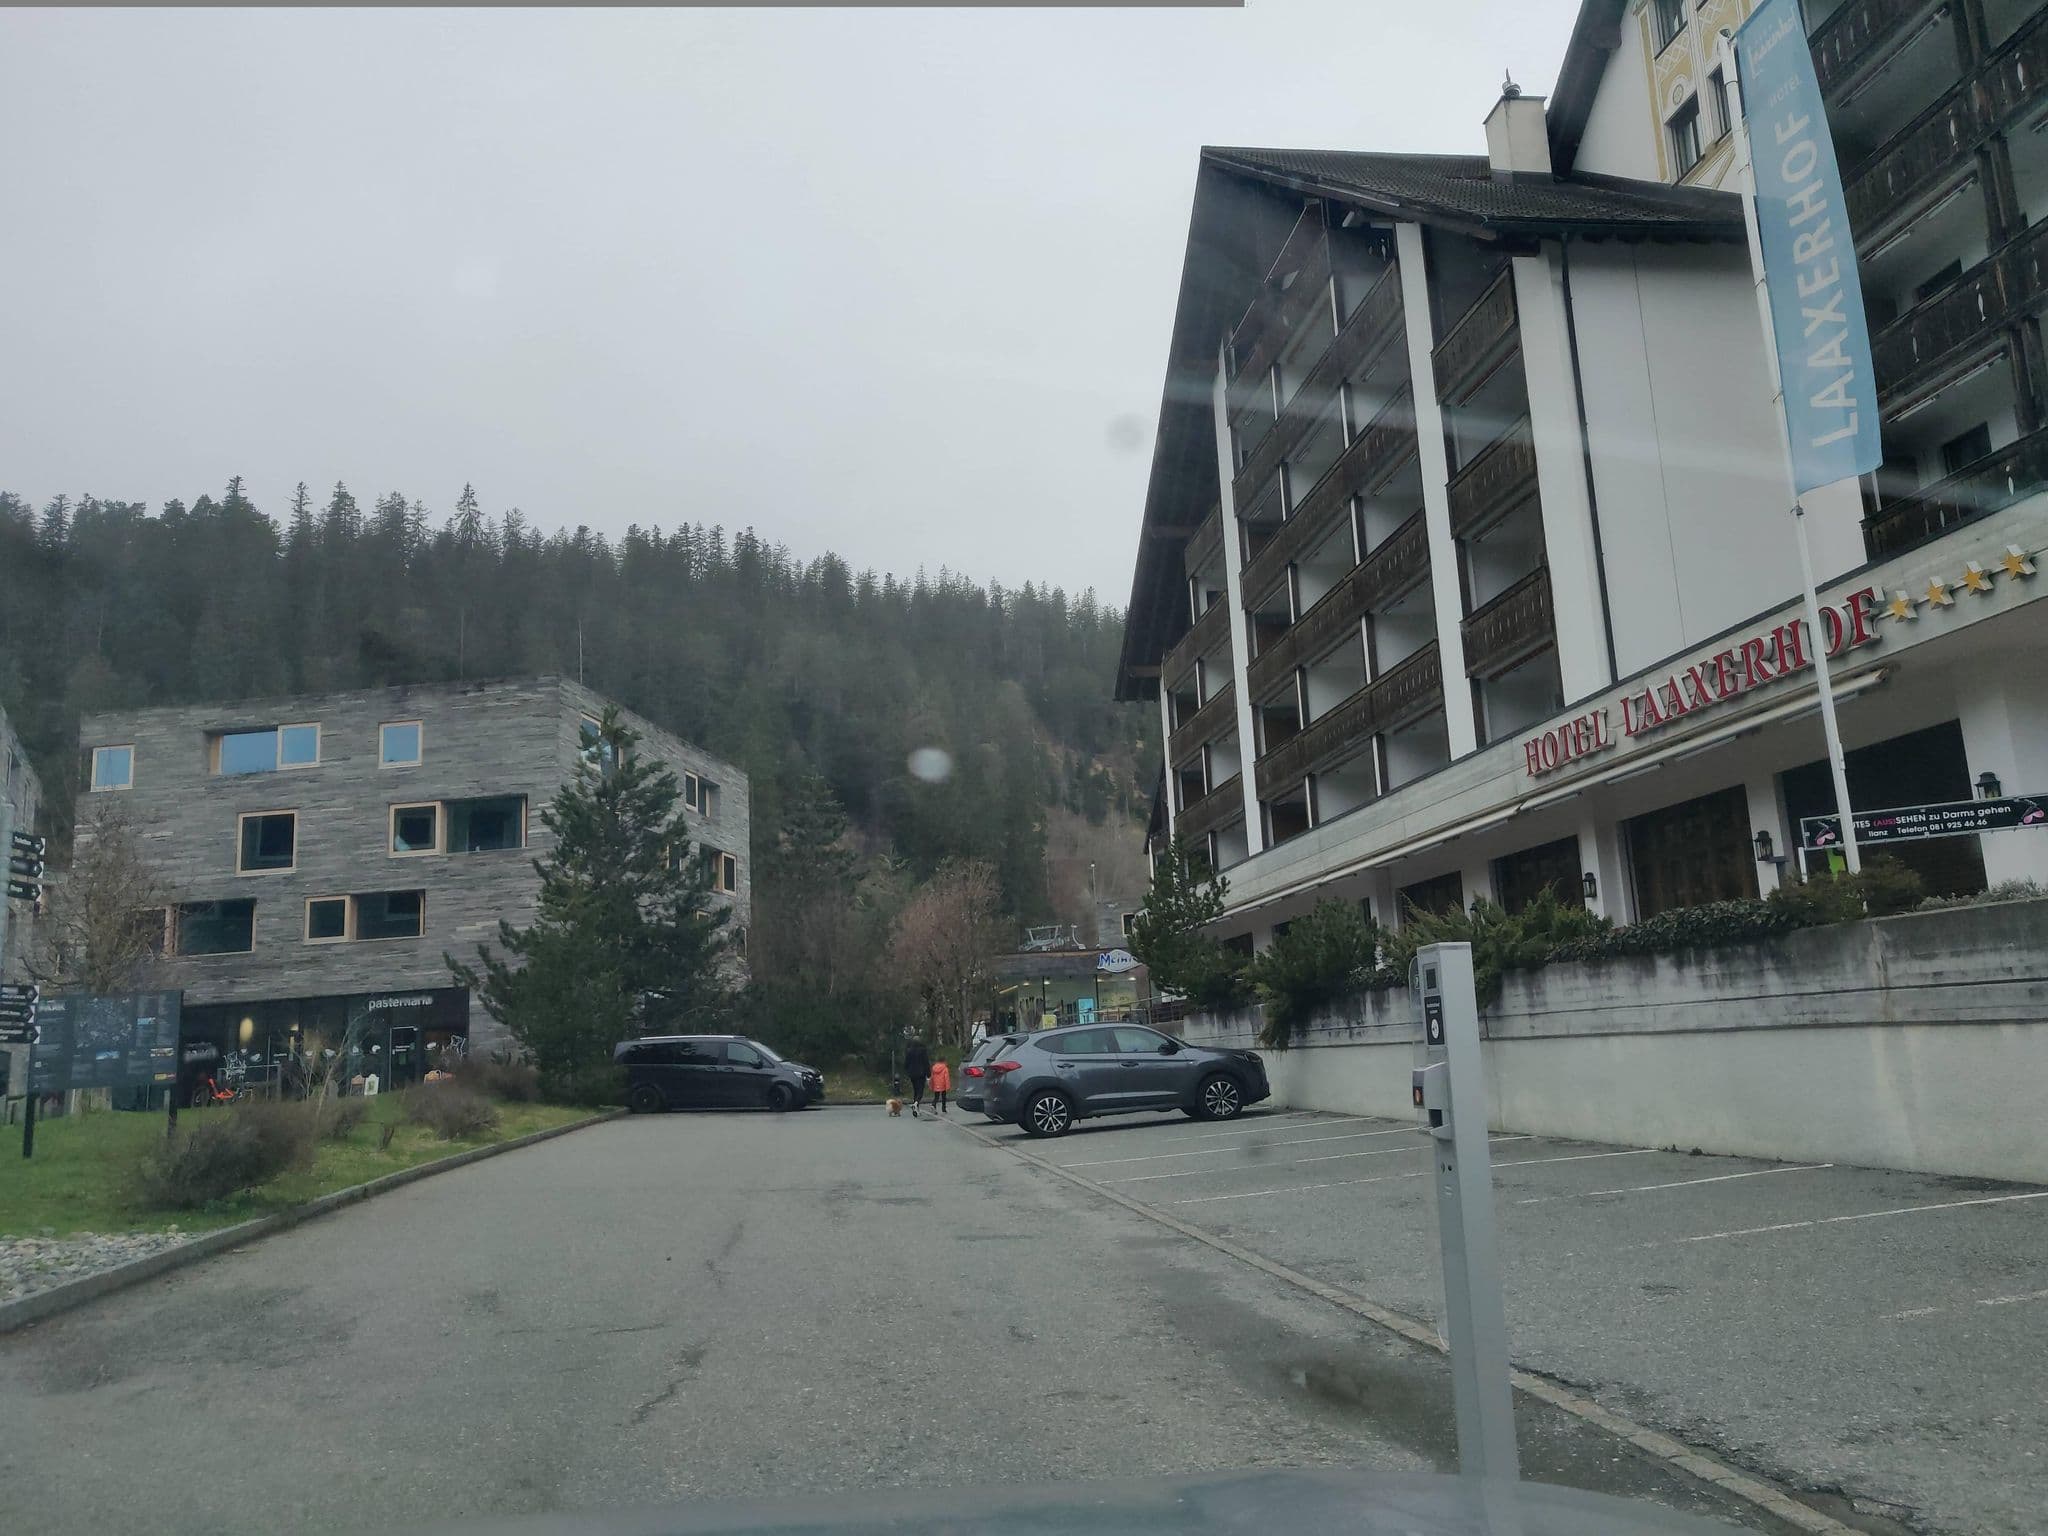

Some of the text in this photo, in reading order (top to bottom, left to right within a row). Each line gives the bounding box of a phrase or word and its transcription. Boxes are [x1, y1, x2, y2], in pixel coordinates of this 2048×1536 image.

[1768, 72, 1802, 107] HOTEL
[1774, 112, 1859, 448] LAAXERHOF
[1524, 586, 1880, 777] HOTEL LAAXERHOF
[1897, 825, 1928, 834] Telefon
[1943, 810, 1975, 820] Darms
[1978, 806, 2011, 817] gehen
